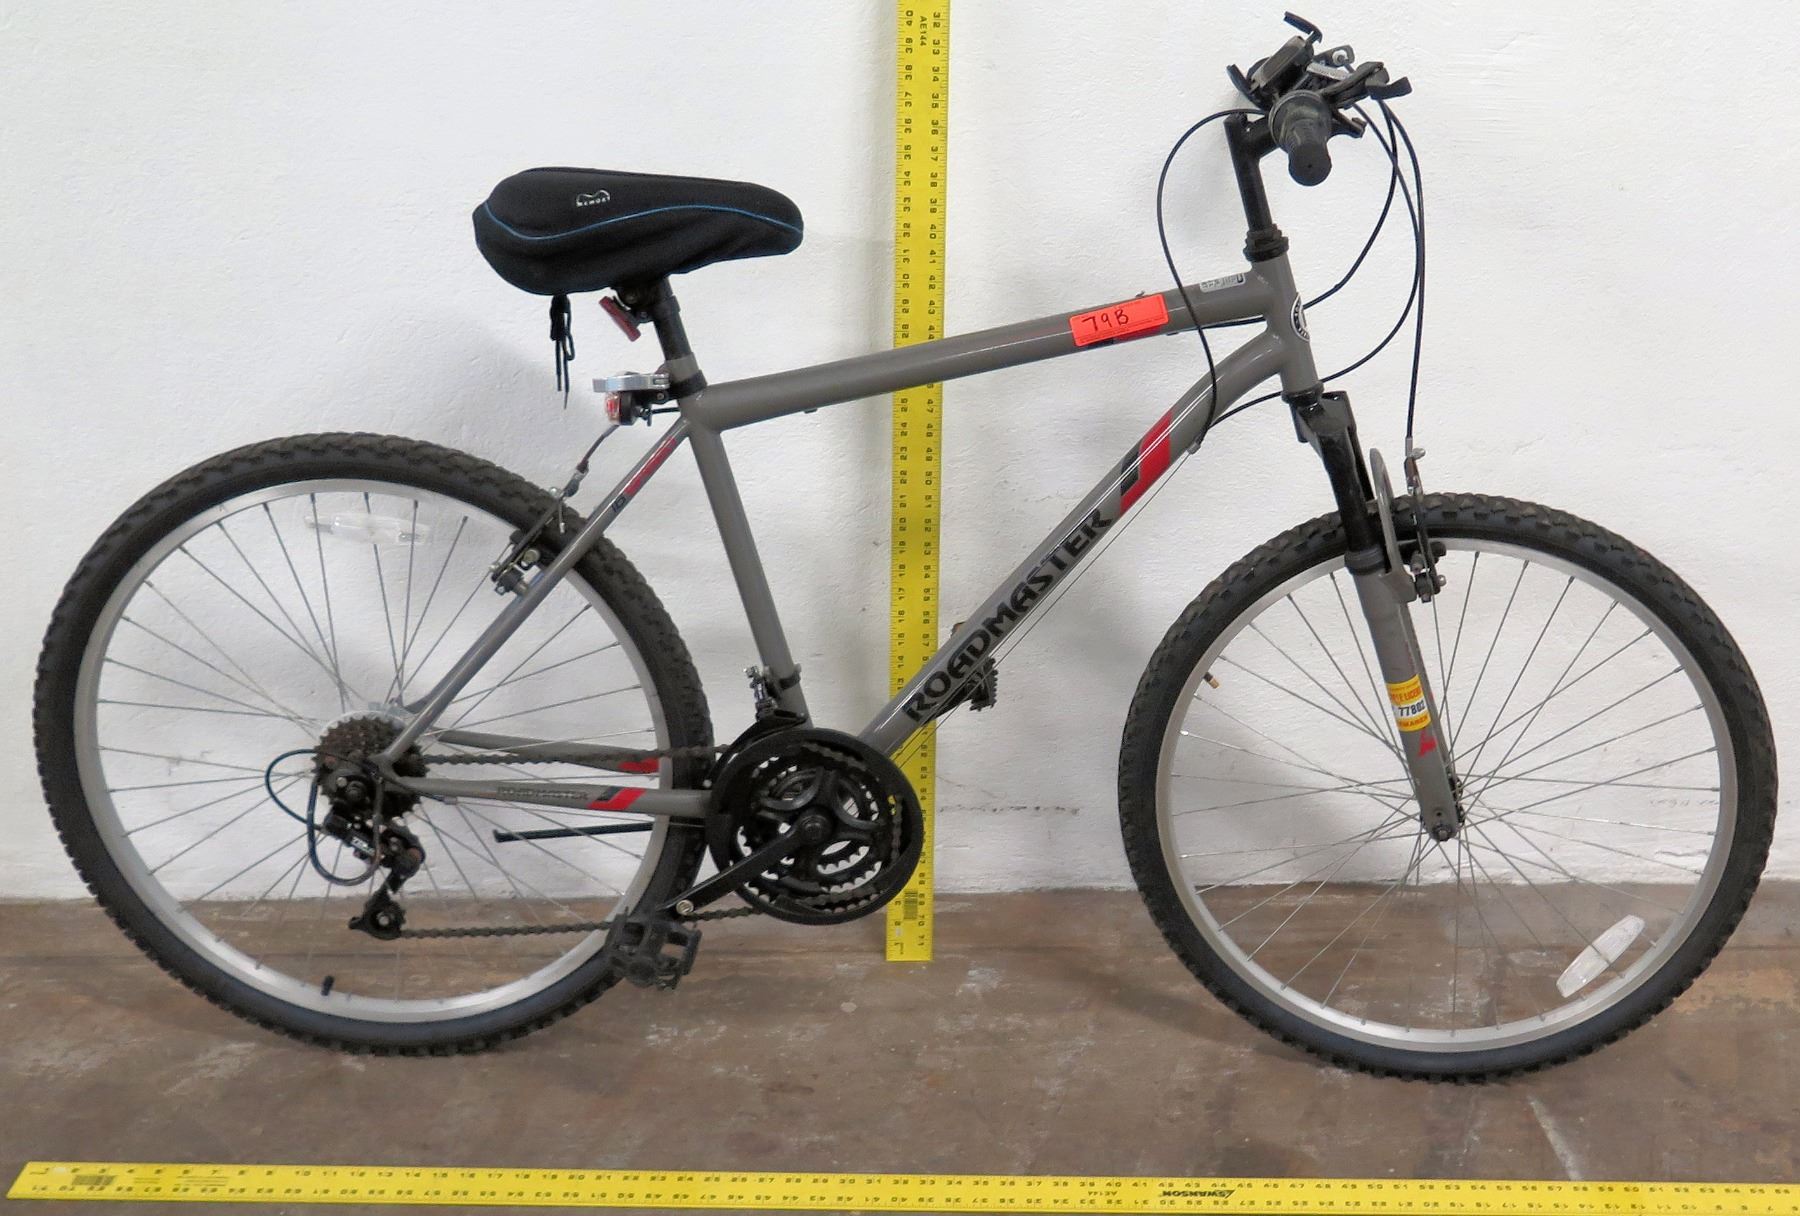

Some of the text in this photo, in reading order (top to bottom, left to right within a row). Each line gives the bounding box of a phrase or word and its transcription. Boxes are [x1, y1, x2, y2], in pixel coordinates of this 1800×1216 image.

[920, 15, 928, 46] AE144
[1081, 308, 1129, 331] 79B
[902, 509, 1113, 722] ROADMASTER
[1161, 1190, 1235, 1199] SWANSON
